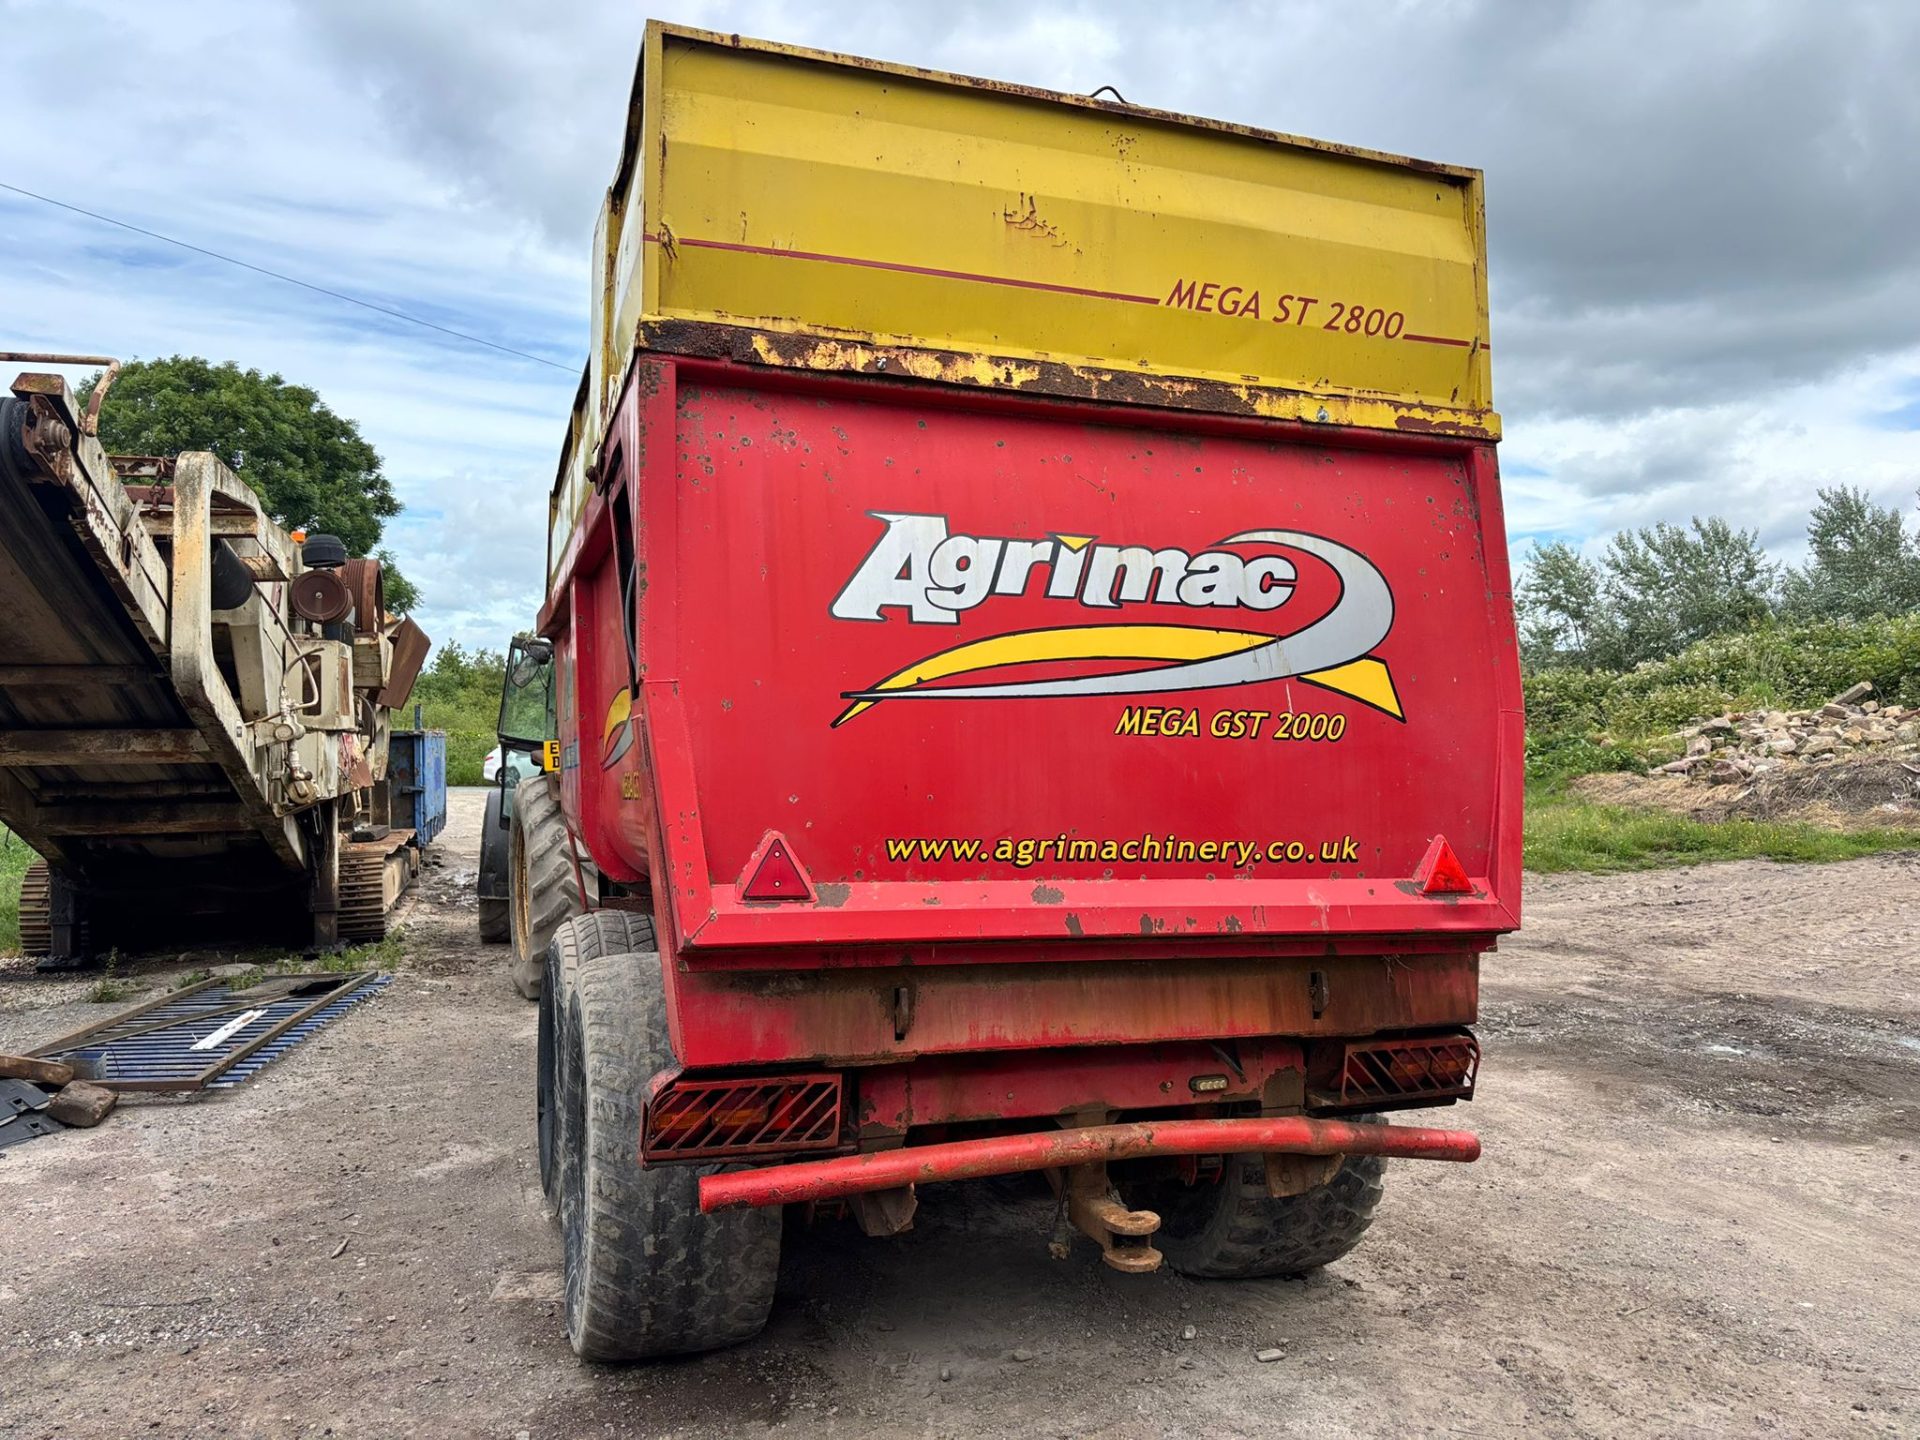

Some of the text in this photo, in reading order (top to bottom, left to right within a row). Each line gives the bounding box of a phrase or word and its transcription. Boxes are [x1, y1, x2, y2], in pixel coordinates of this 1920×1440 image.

[1165, 278, 1405, 339] MEGA ST 2800
[831, 511, 1297, 625] Agrimac
[1115, 706, 1347, 742] MEGA GST 2000
[886, 833, 1359, 869] www.agrimachinery.co.uk
